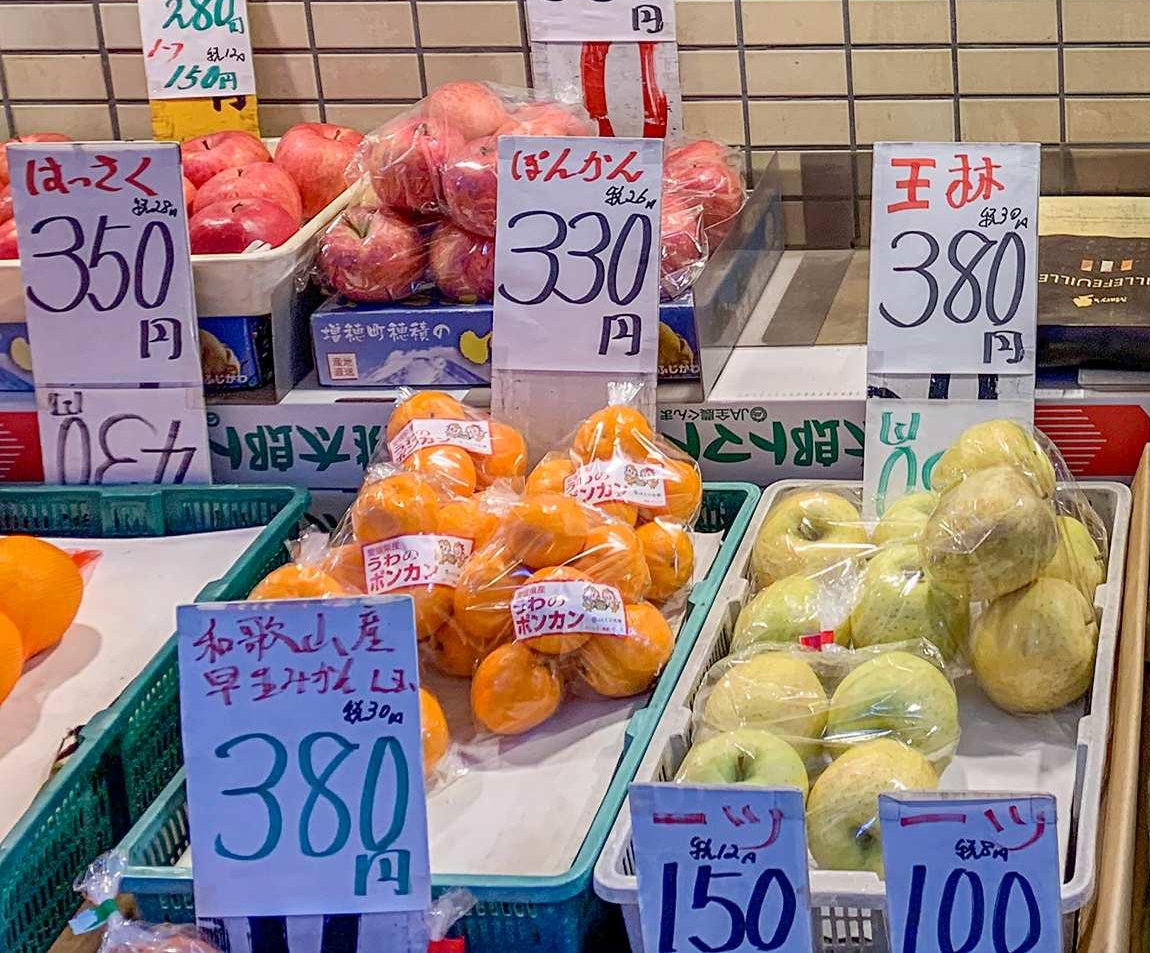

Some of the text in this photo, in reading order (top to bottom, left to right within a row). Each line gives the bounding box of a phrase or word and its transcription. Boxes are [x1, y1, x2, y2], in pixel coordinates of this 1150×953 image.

[632, 4, 664, 33] 円
[25, 155, 158, 196] はっさく
[887, 153, 1006, 214] 王林
[26, 215, 175, 313] 350
[498, 210, 652, 306] 330
[879, 230, 1026, 328] 380
[140, 317, 182, 360] 円
[598, 313, 642, 355] 円
[983, 330, 1025, 364] 円
[193, 605, 394, 663] 和歌山産
[214, 731, 410, 860] 380
[354, 848, 411, 897] 円
[658, 862, 797, 953] 150
[903, 864, 1042, 953] 100
